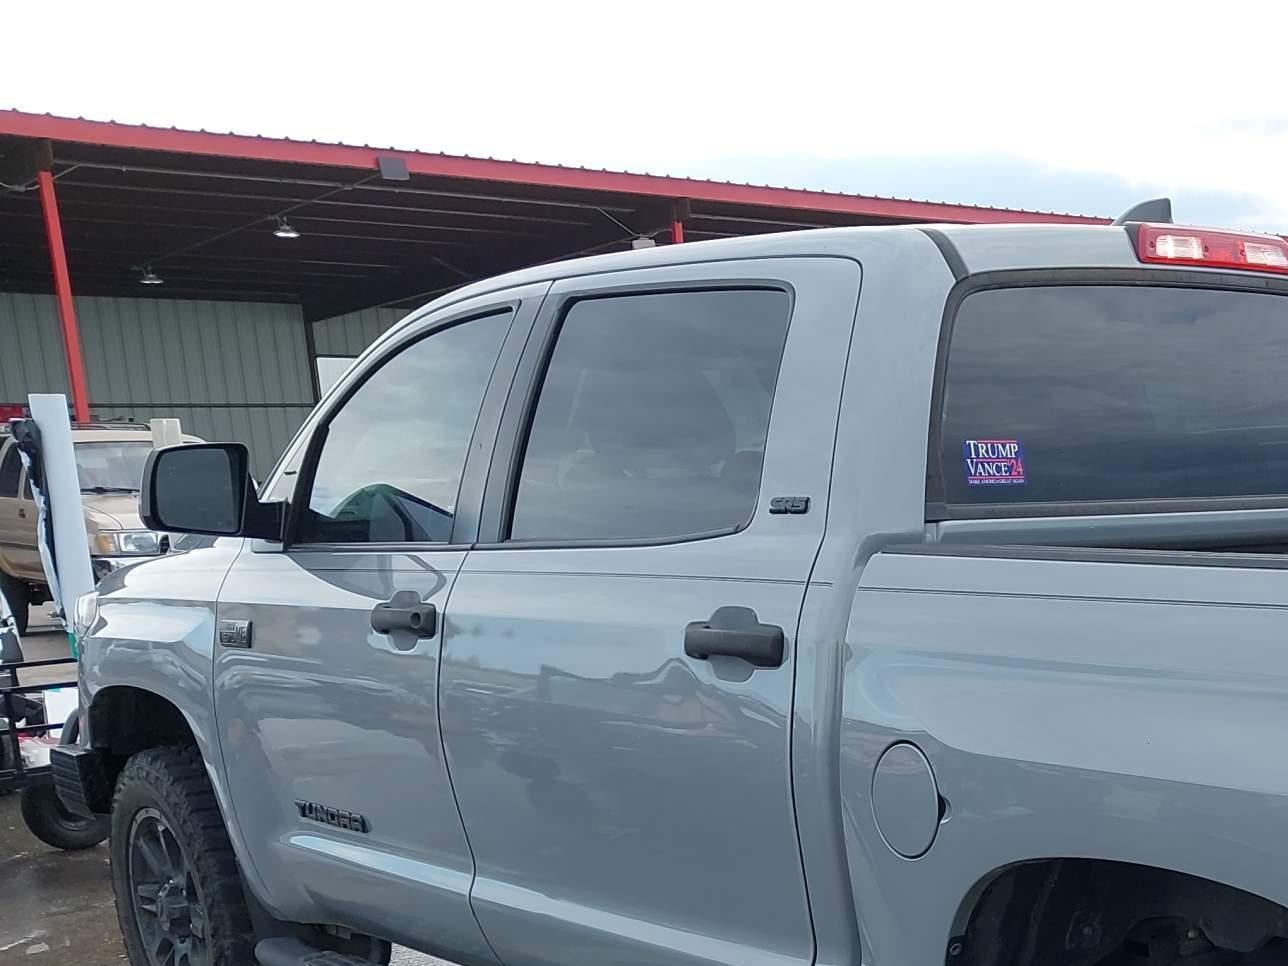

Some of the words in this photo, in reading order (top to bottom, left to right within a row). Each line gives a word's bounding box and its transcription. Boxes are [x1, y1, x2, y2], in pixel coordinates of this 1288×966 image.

[966, 440, 1019, 458] TRUMP
[966, 459, 1009, 476] VANCE
[294, 799, 369, 833] TUNDRA
